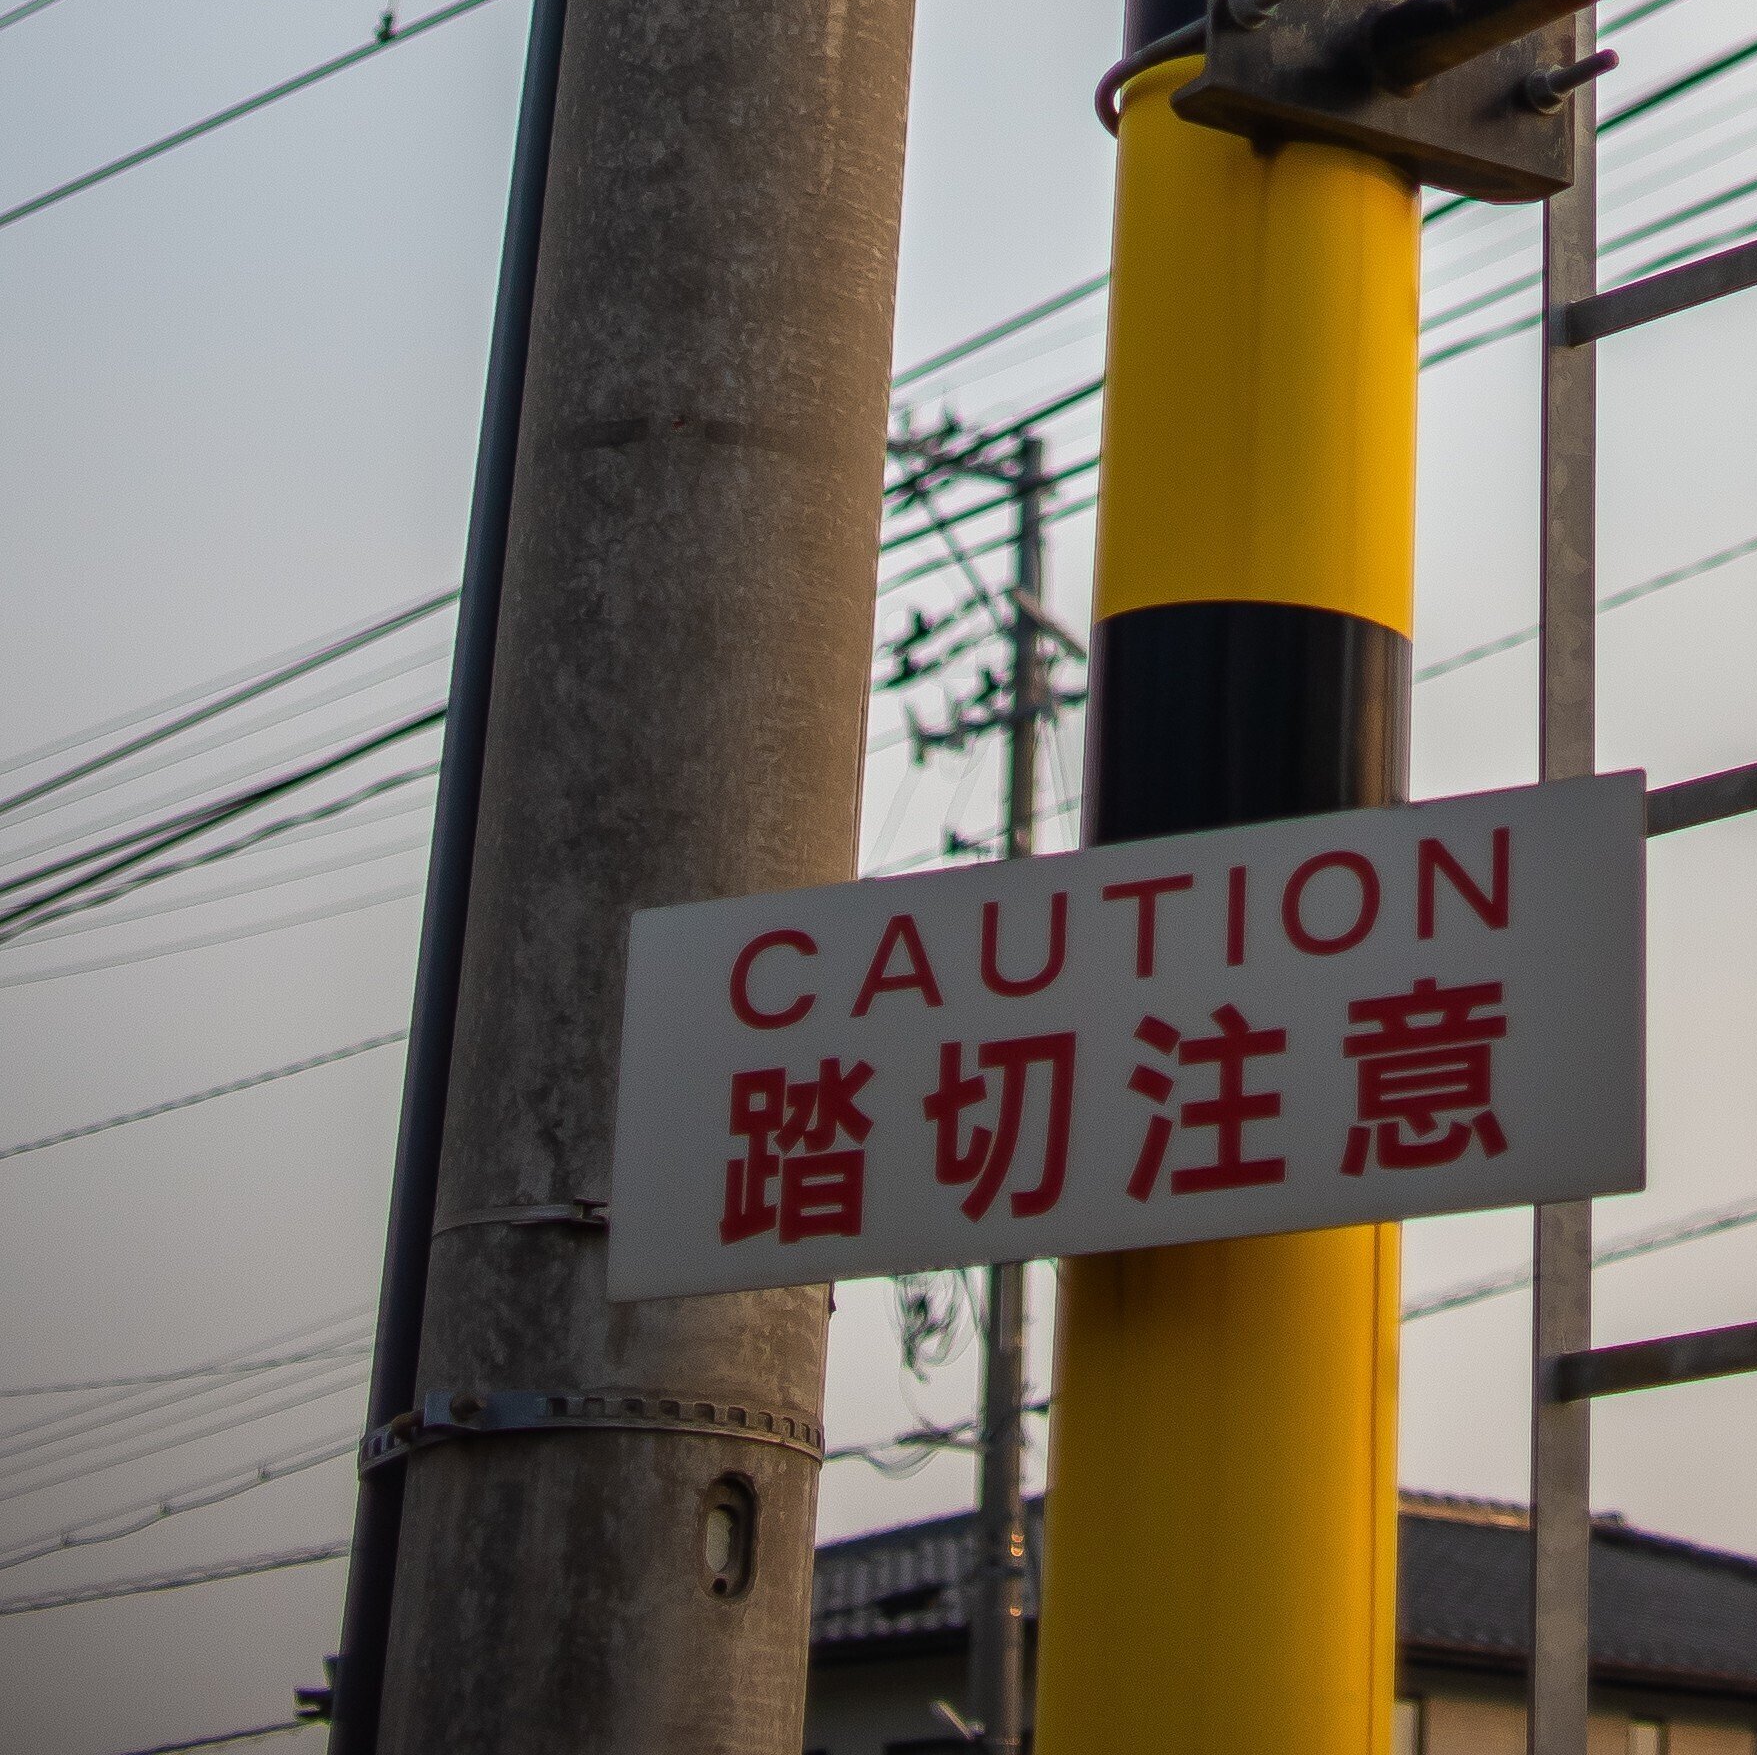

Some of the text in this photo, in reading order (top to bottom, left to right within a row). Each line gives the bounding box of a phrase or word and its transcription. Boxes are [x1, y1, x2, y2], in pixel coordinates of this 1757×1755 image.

[729, 827, 1510, 1030] CAUTION
[719, 977, 1508, 1244] 踏切注意
